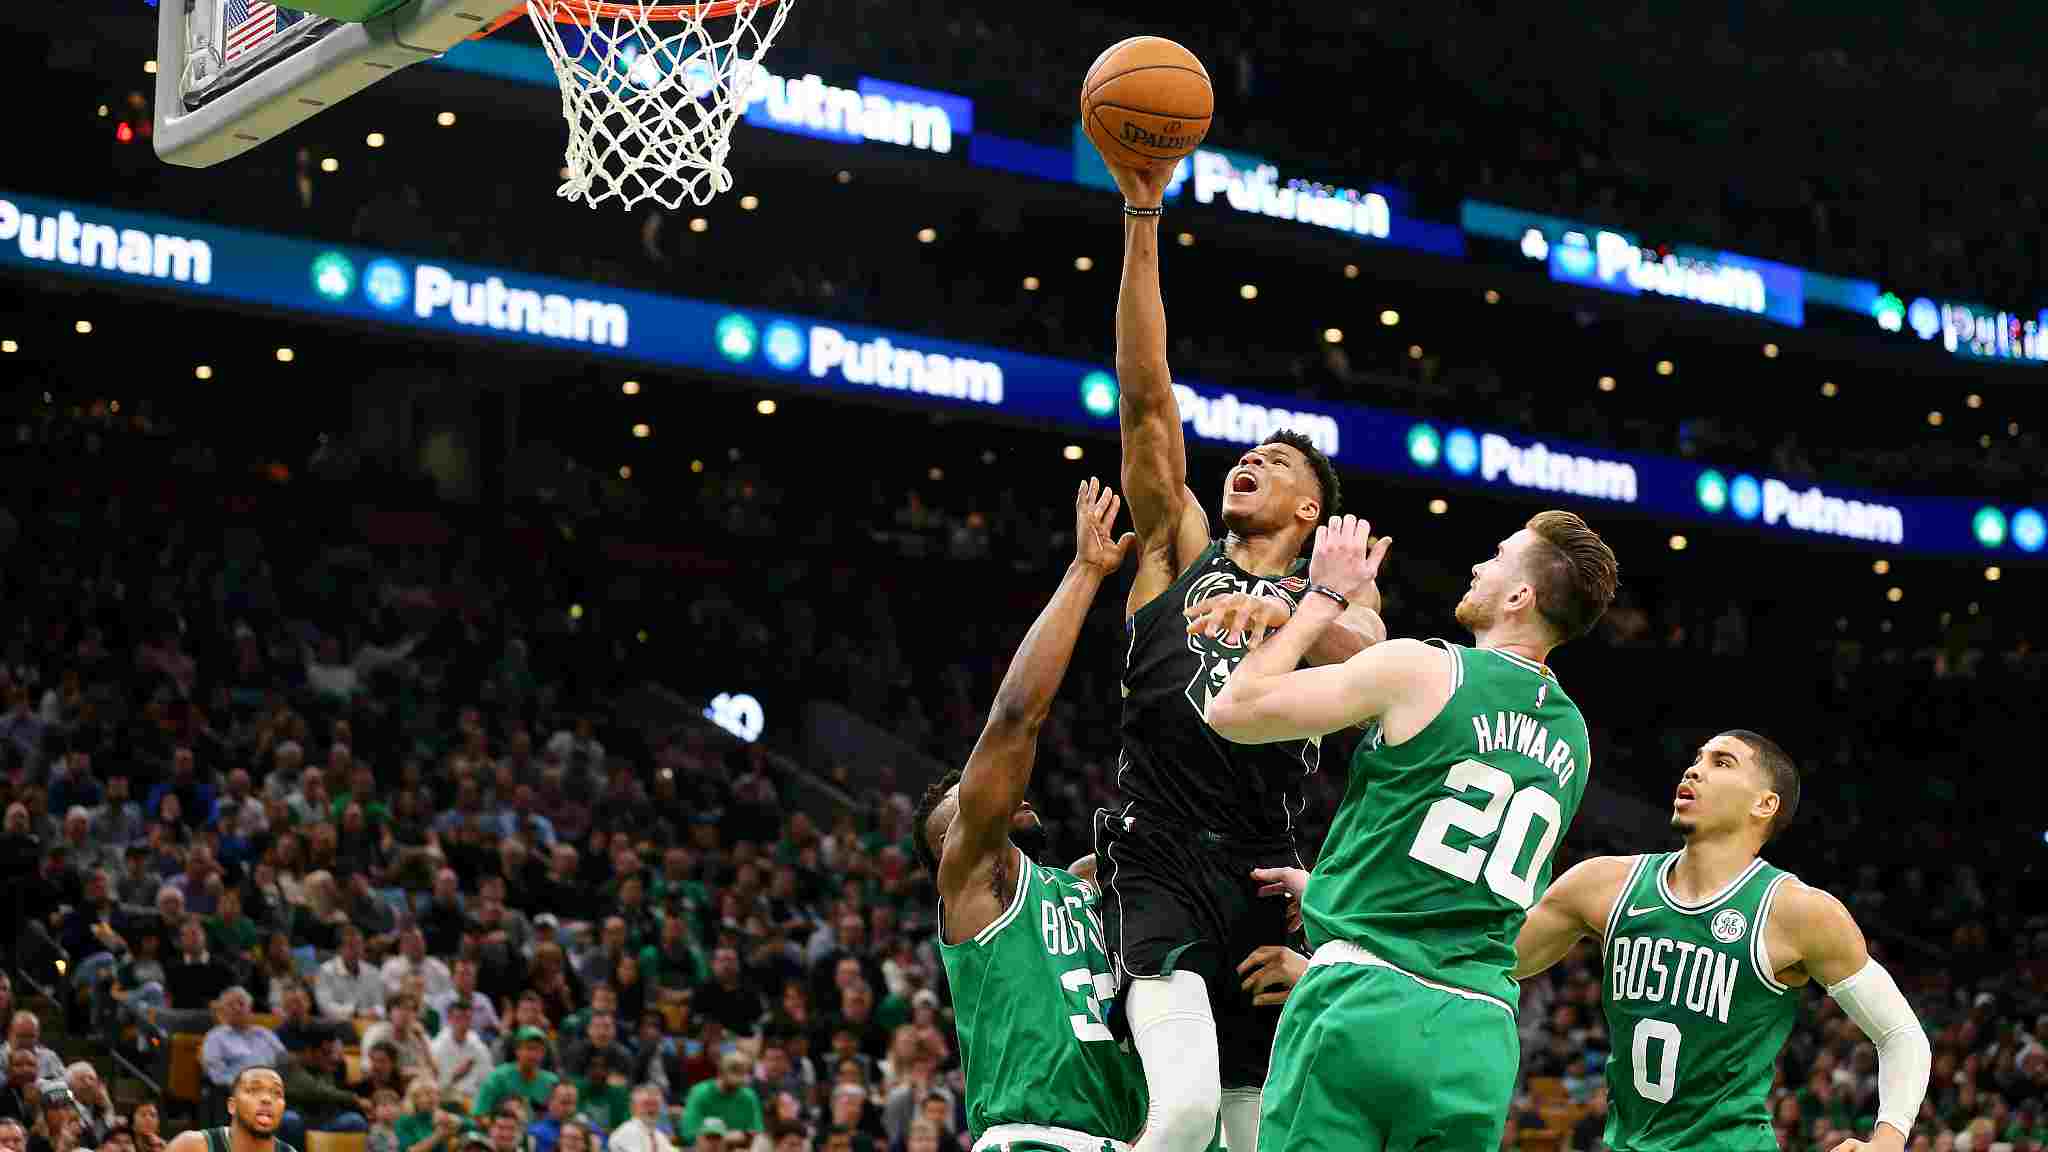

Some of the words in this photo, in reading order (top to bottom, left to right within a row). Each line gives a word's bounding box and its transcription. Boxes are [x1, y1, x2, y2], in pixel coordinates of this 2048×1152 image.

[734, 58, 951, 153] Putnam
[415, 265, 628, 347] Putnam
[809, 326, 1003, 404] Putnam
[1481, 433, 1637, 502] Putnam
[1763, 479, 1903, 543] Putnam
[1472, 711, 1575, 789] HAYWARD
[1408, 758, 1561, 911] 20
[1612, 936, 1740, 1024] BOSTON
[1631, 1018, 1682, 1104] 0
